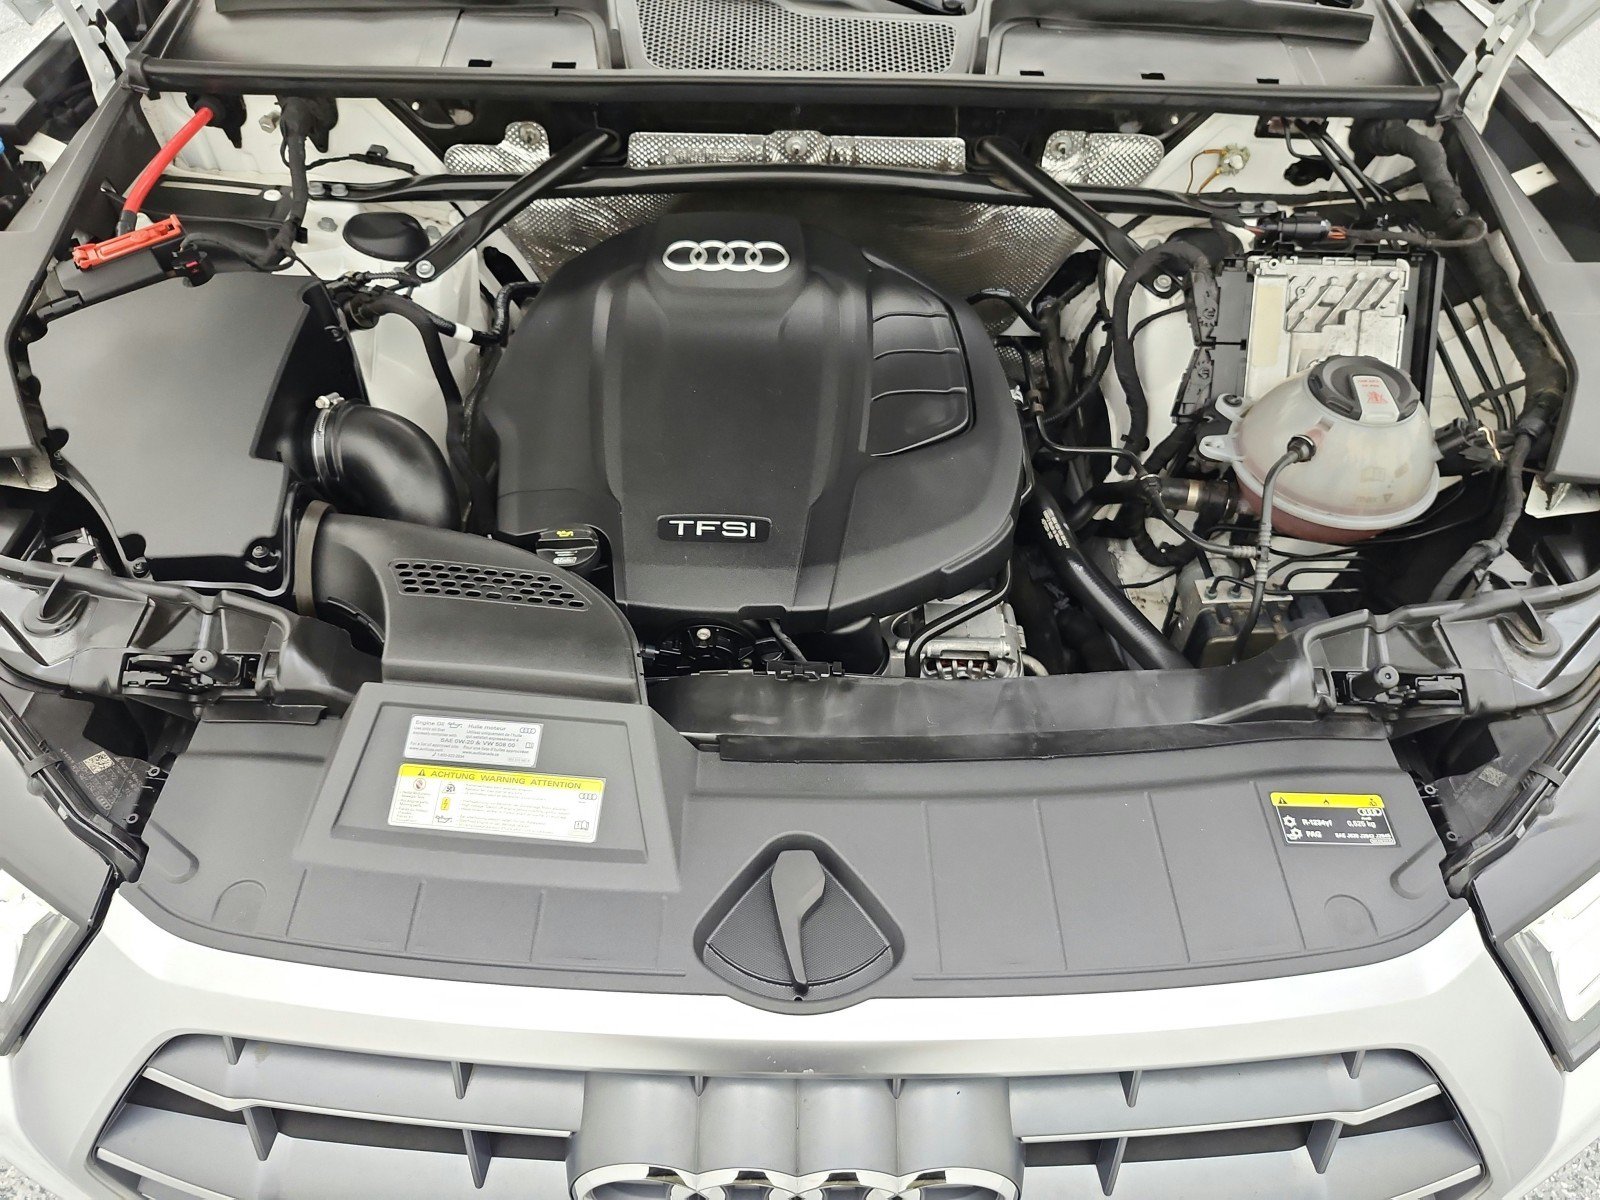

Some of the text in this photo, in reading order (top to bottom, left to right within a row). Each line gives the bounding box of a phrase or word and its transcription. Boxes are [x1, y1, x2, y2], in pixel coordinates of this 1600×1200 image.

[668, 519, 756, 538] TFSI
[431, 770, 582, 789] ACHTUNG WARNING ATTENTION
[1301, 818, 1333, 828] R-1234yf
[1305, 830, 1323, 838] PAG
